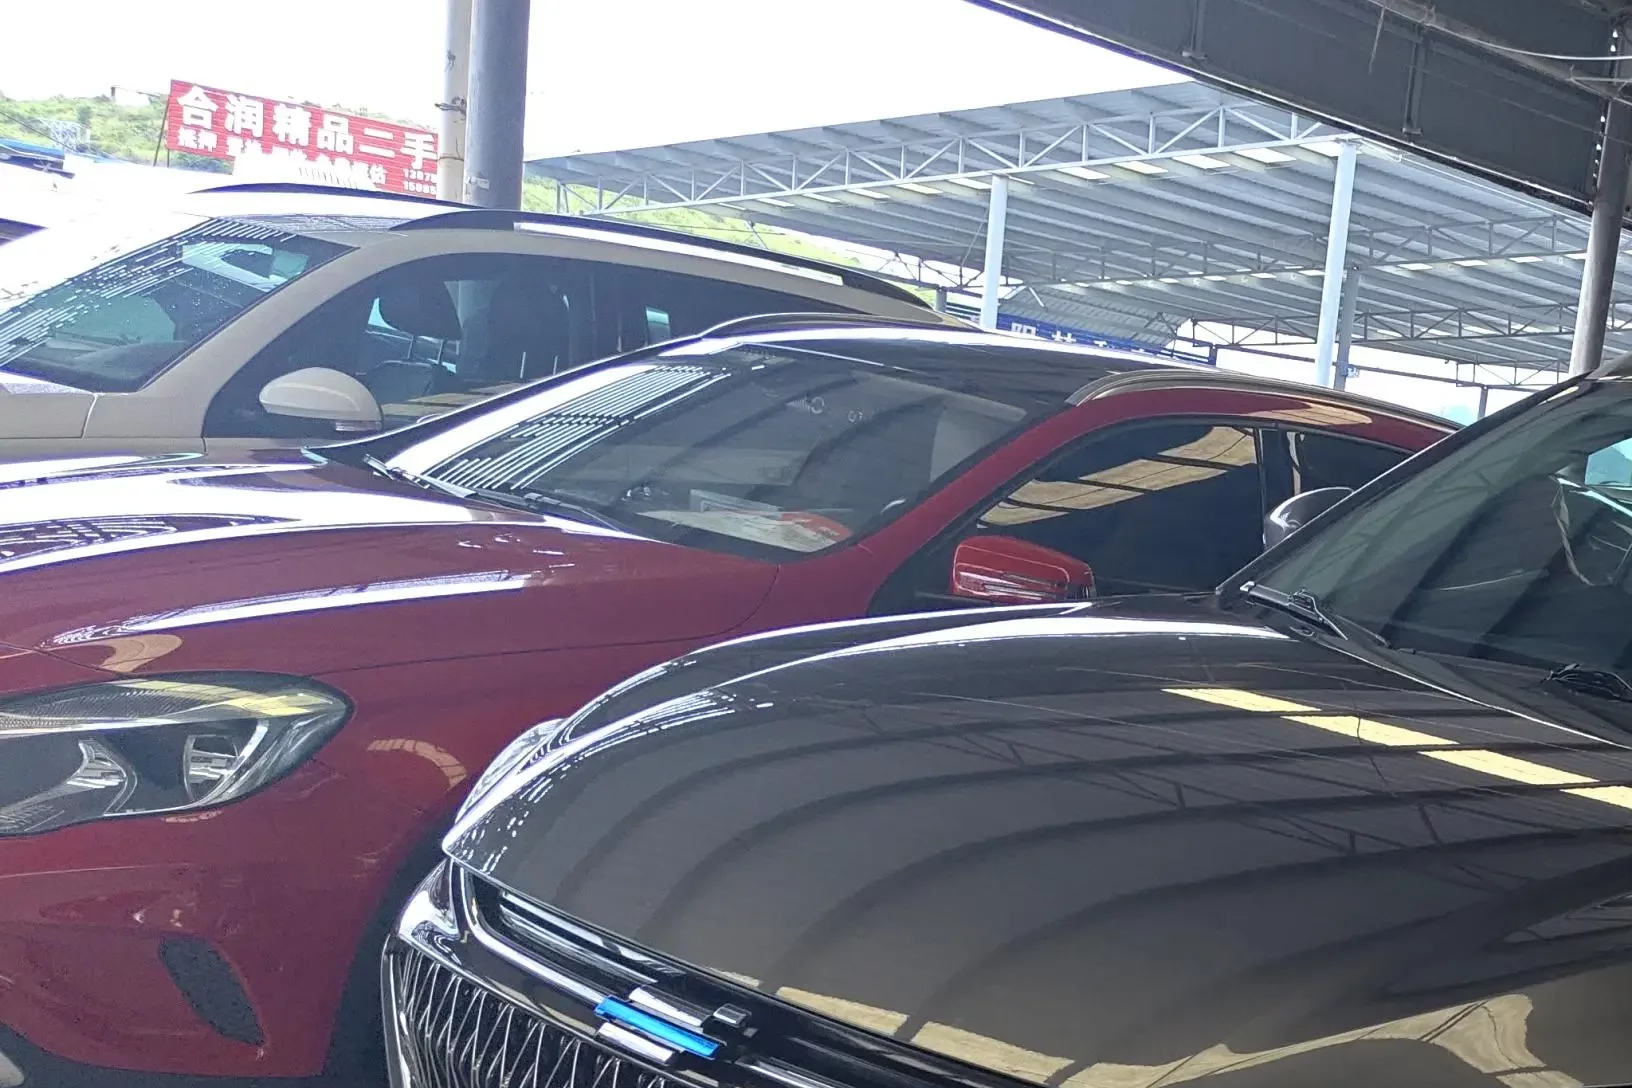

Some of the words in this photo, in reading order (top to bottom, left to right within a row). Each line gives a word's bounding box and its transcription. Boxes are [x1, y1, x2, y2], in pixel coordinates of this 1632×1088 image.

[177, 85, 438, 169] 合润精品二手
